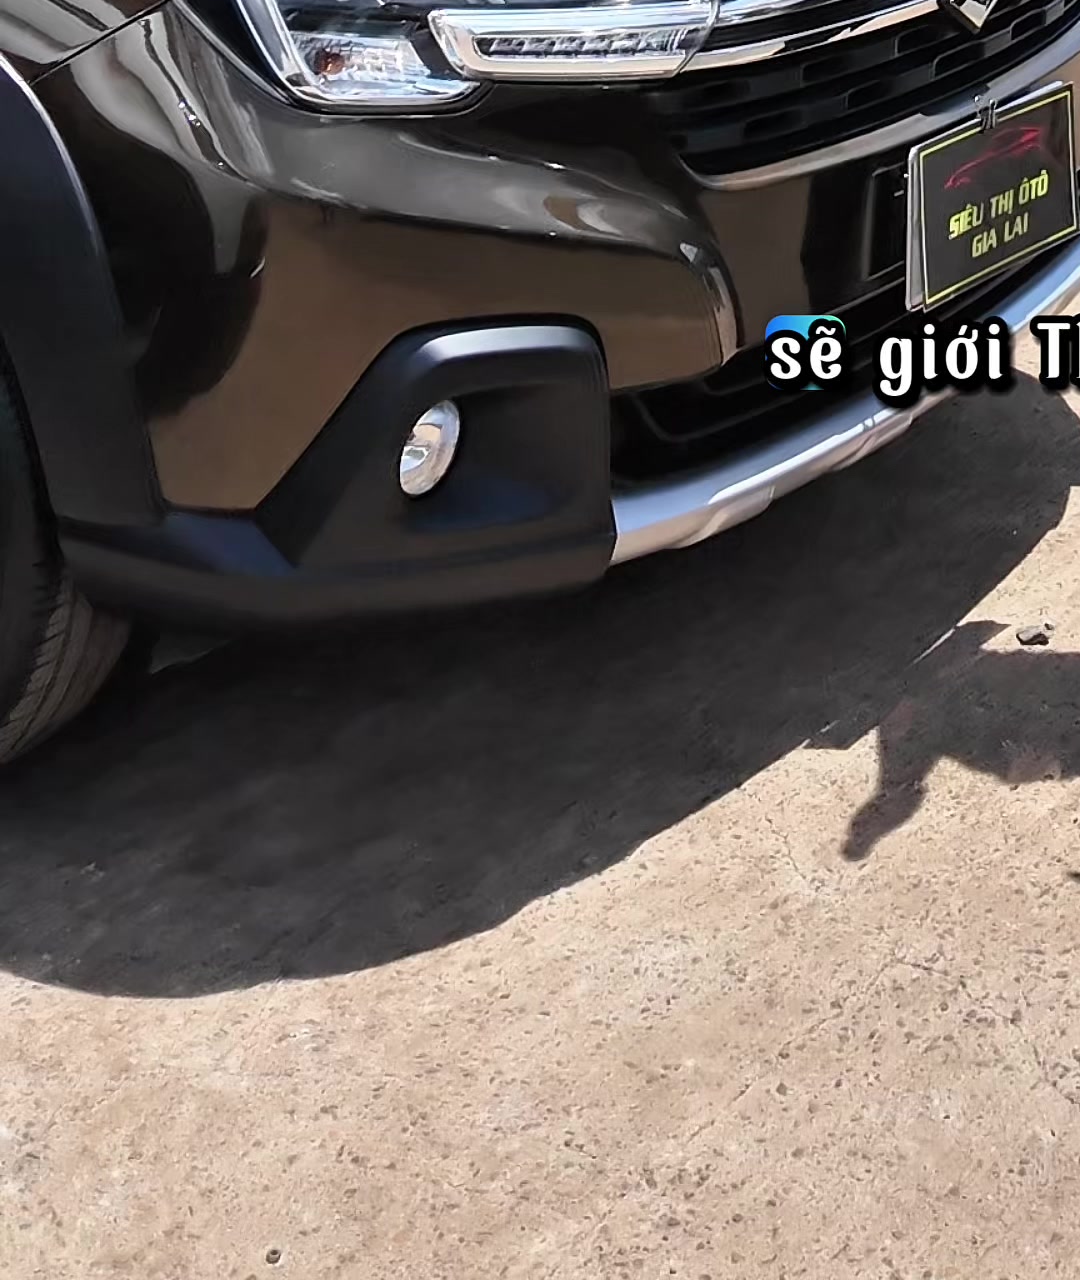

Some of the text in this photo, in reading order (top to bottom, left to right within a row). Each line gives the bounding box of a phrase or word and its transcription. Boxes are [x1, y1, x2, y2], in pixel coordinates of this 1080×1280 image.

[948, 201, 984, 240] SIÊU
[989, 188, 1015, 219] THỊ
[971, 212, 1030, 258] GIA LAI
